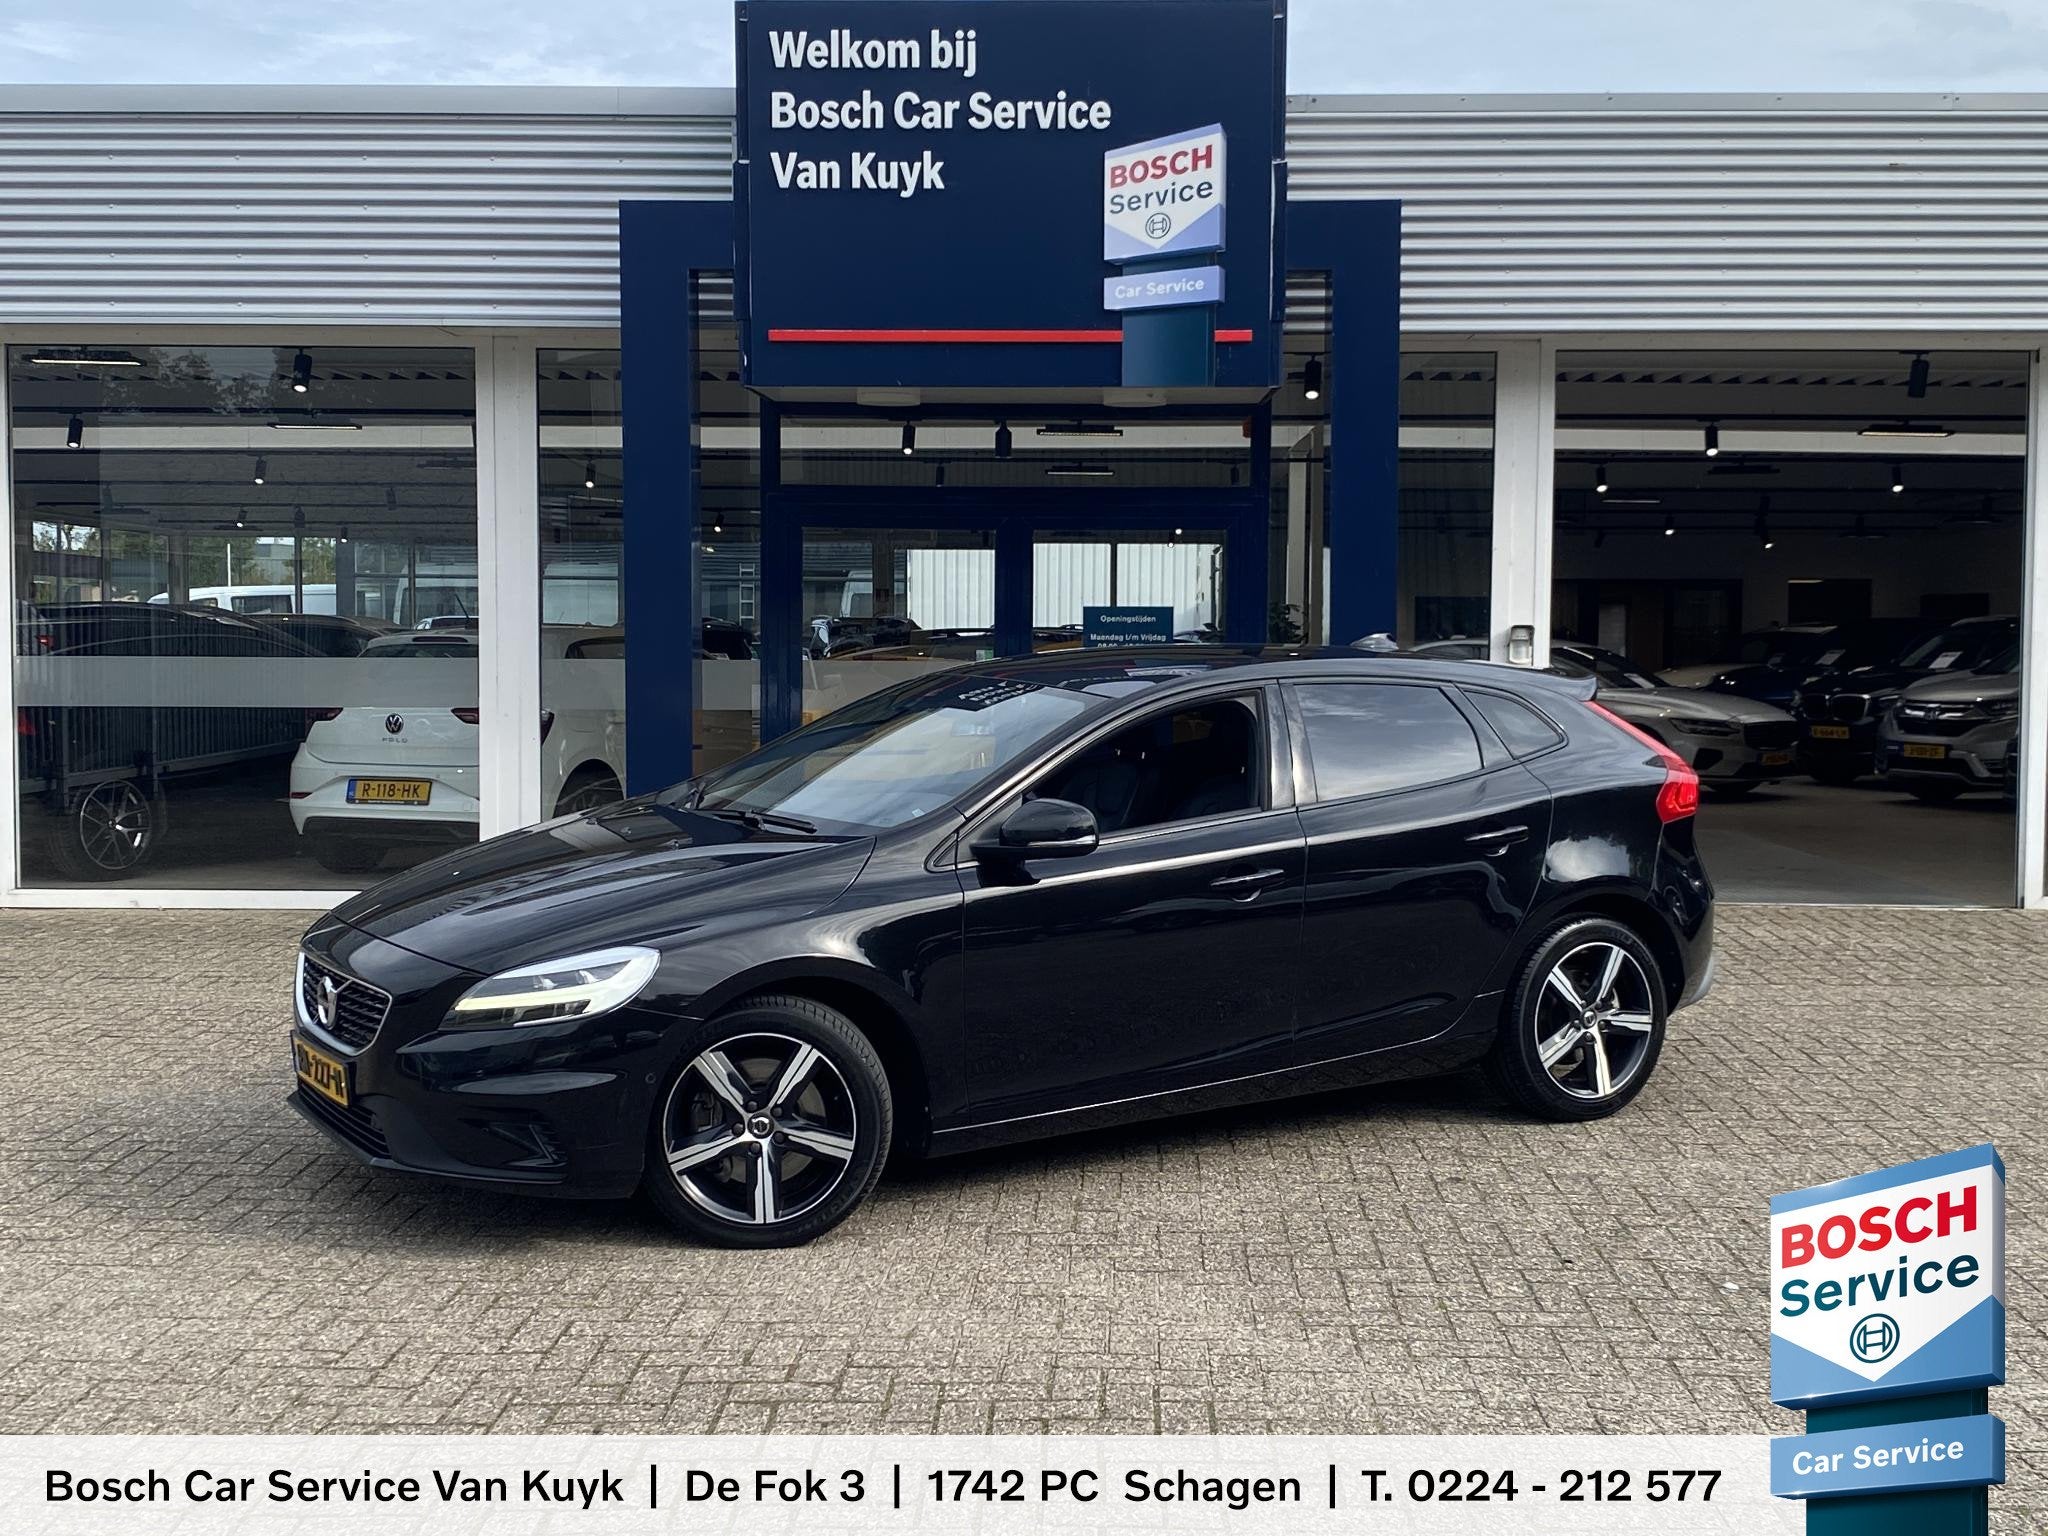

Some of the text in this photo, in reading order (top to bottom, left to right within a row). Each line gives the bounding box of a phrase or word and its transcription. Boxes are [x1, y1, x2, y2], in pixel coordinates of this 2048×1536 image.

[769, 29, 977, 77] Welkom bij
[770, 90, 1112, 130] Bosch Car Service
[769, 150, 945, 198] Van Kuyk
[1109, 144, 1213, 189] BOSCH
[1109, 181, 1213, 215] Service
[1114, 278, 1205, 299] Car Service
[1100, 615, 1157, 623] Openingstijden
[1090, 633, 1167, 642] Maandag t/m Vrijdag
[361, 783, 421, 798] R-118-HK
